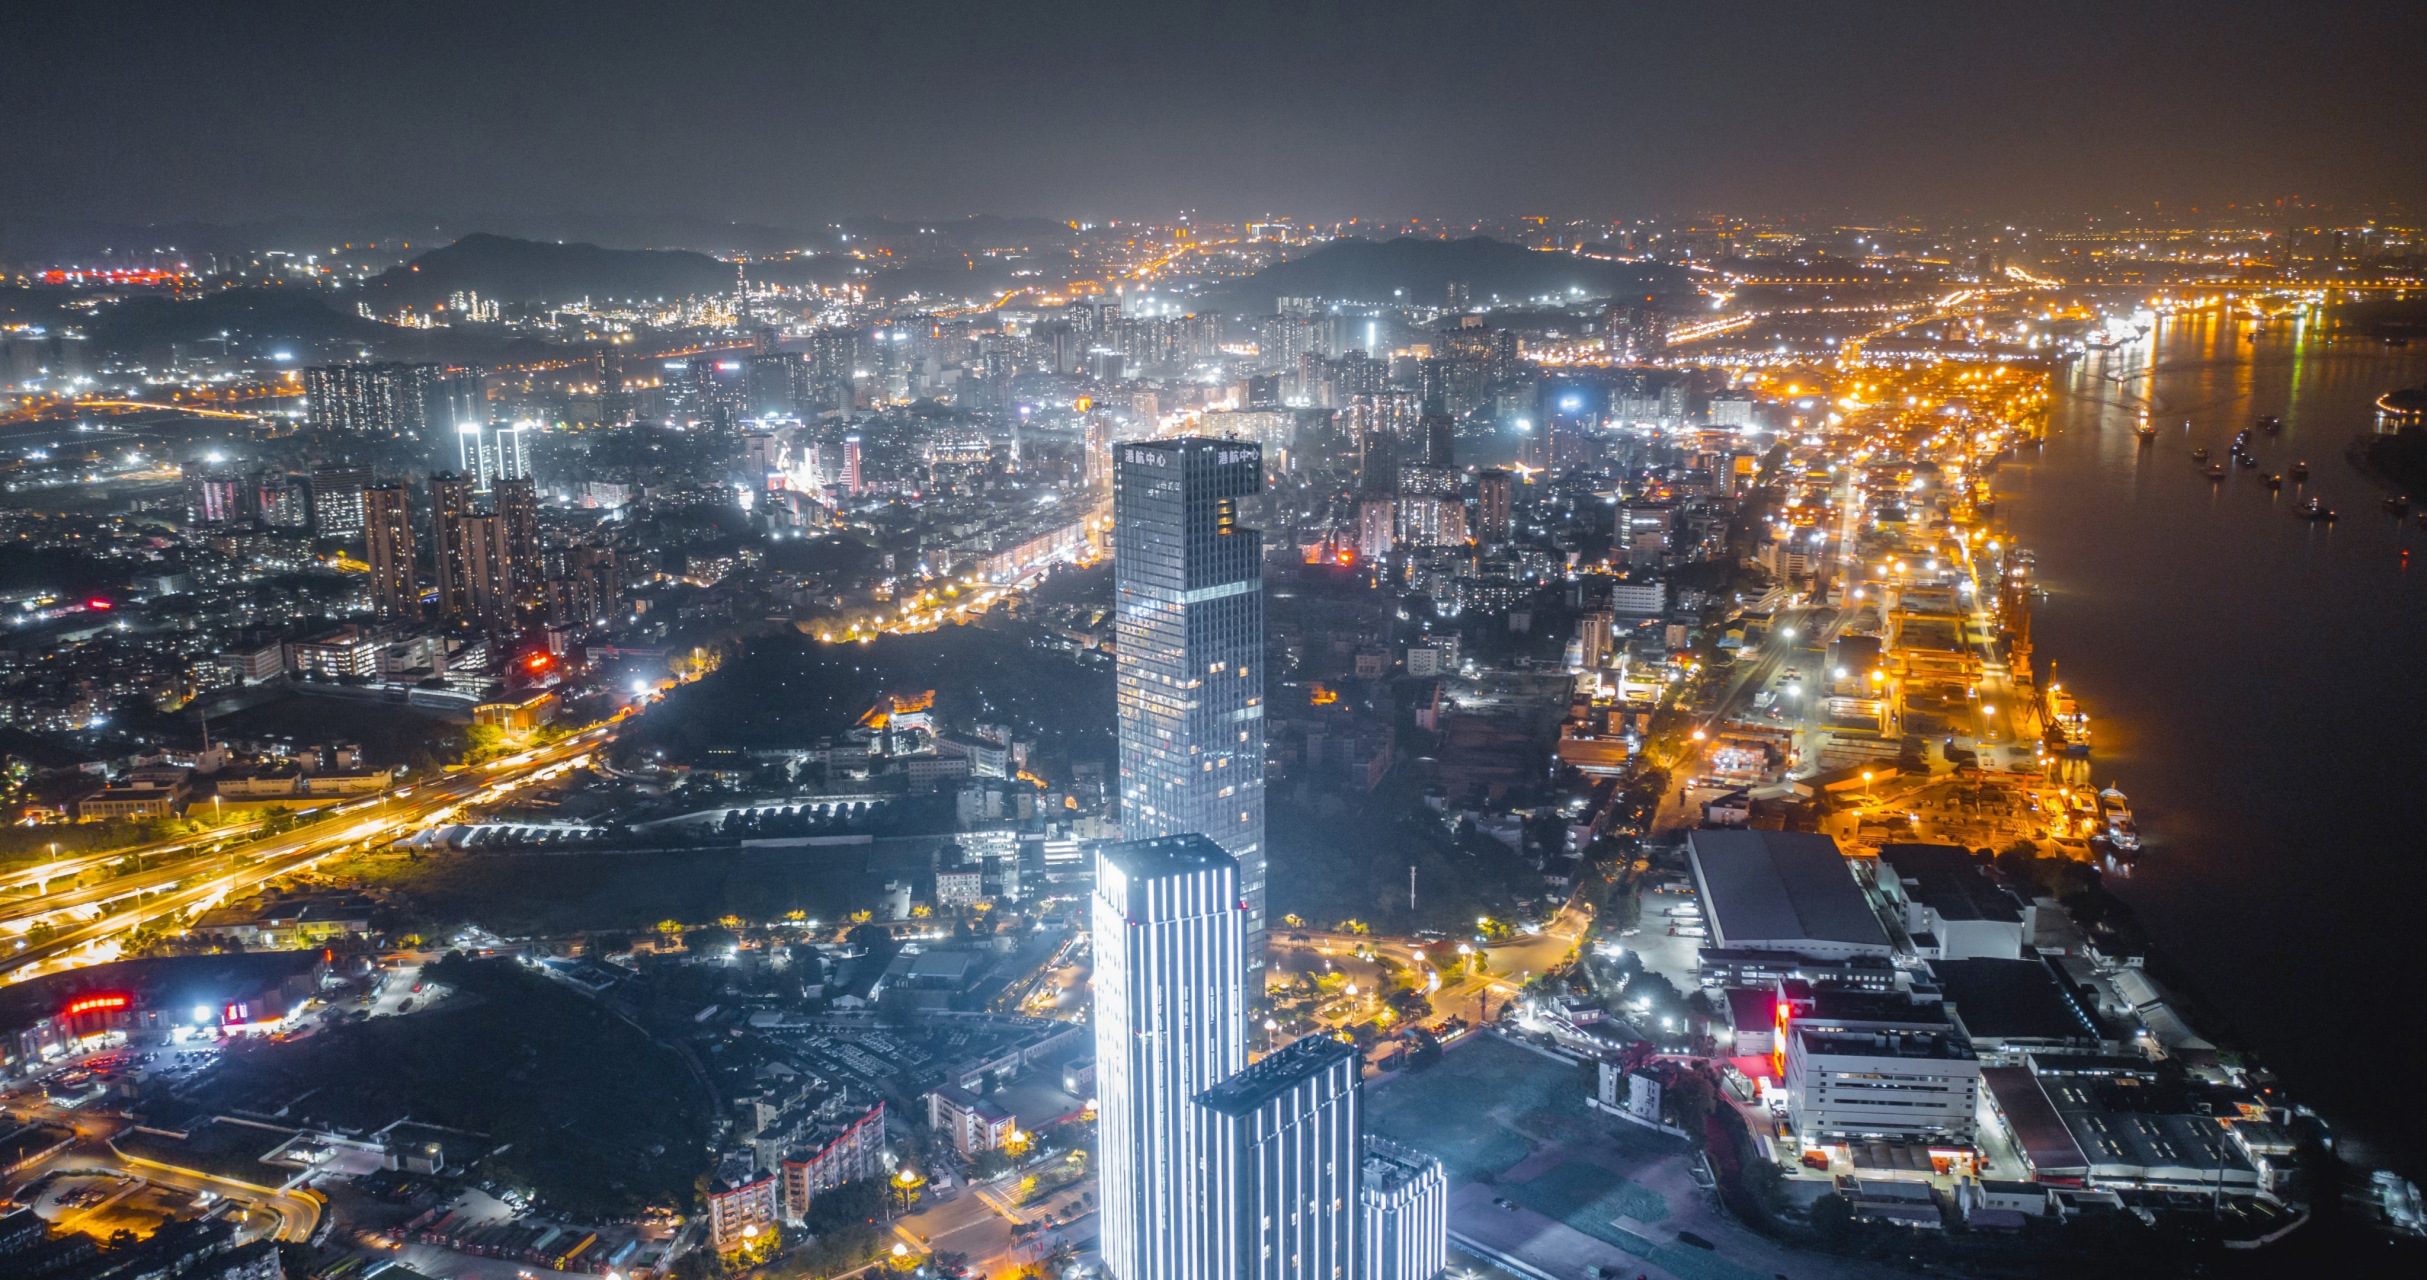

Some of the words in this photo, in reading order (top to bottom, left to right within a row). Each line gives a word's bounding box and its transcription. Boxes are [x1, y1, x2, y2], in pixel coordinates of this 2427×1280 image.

[1125, 449, 1166, 467] 港航中心
[1218, 448, 1260, 465] 港航中心
